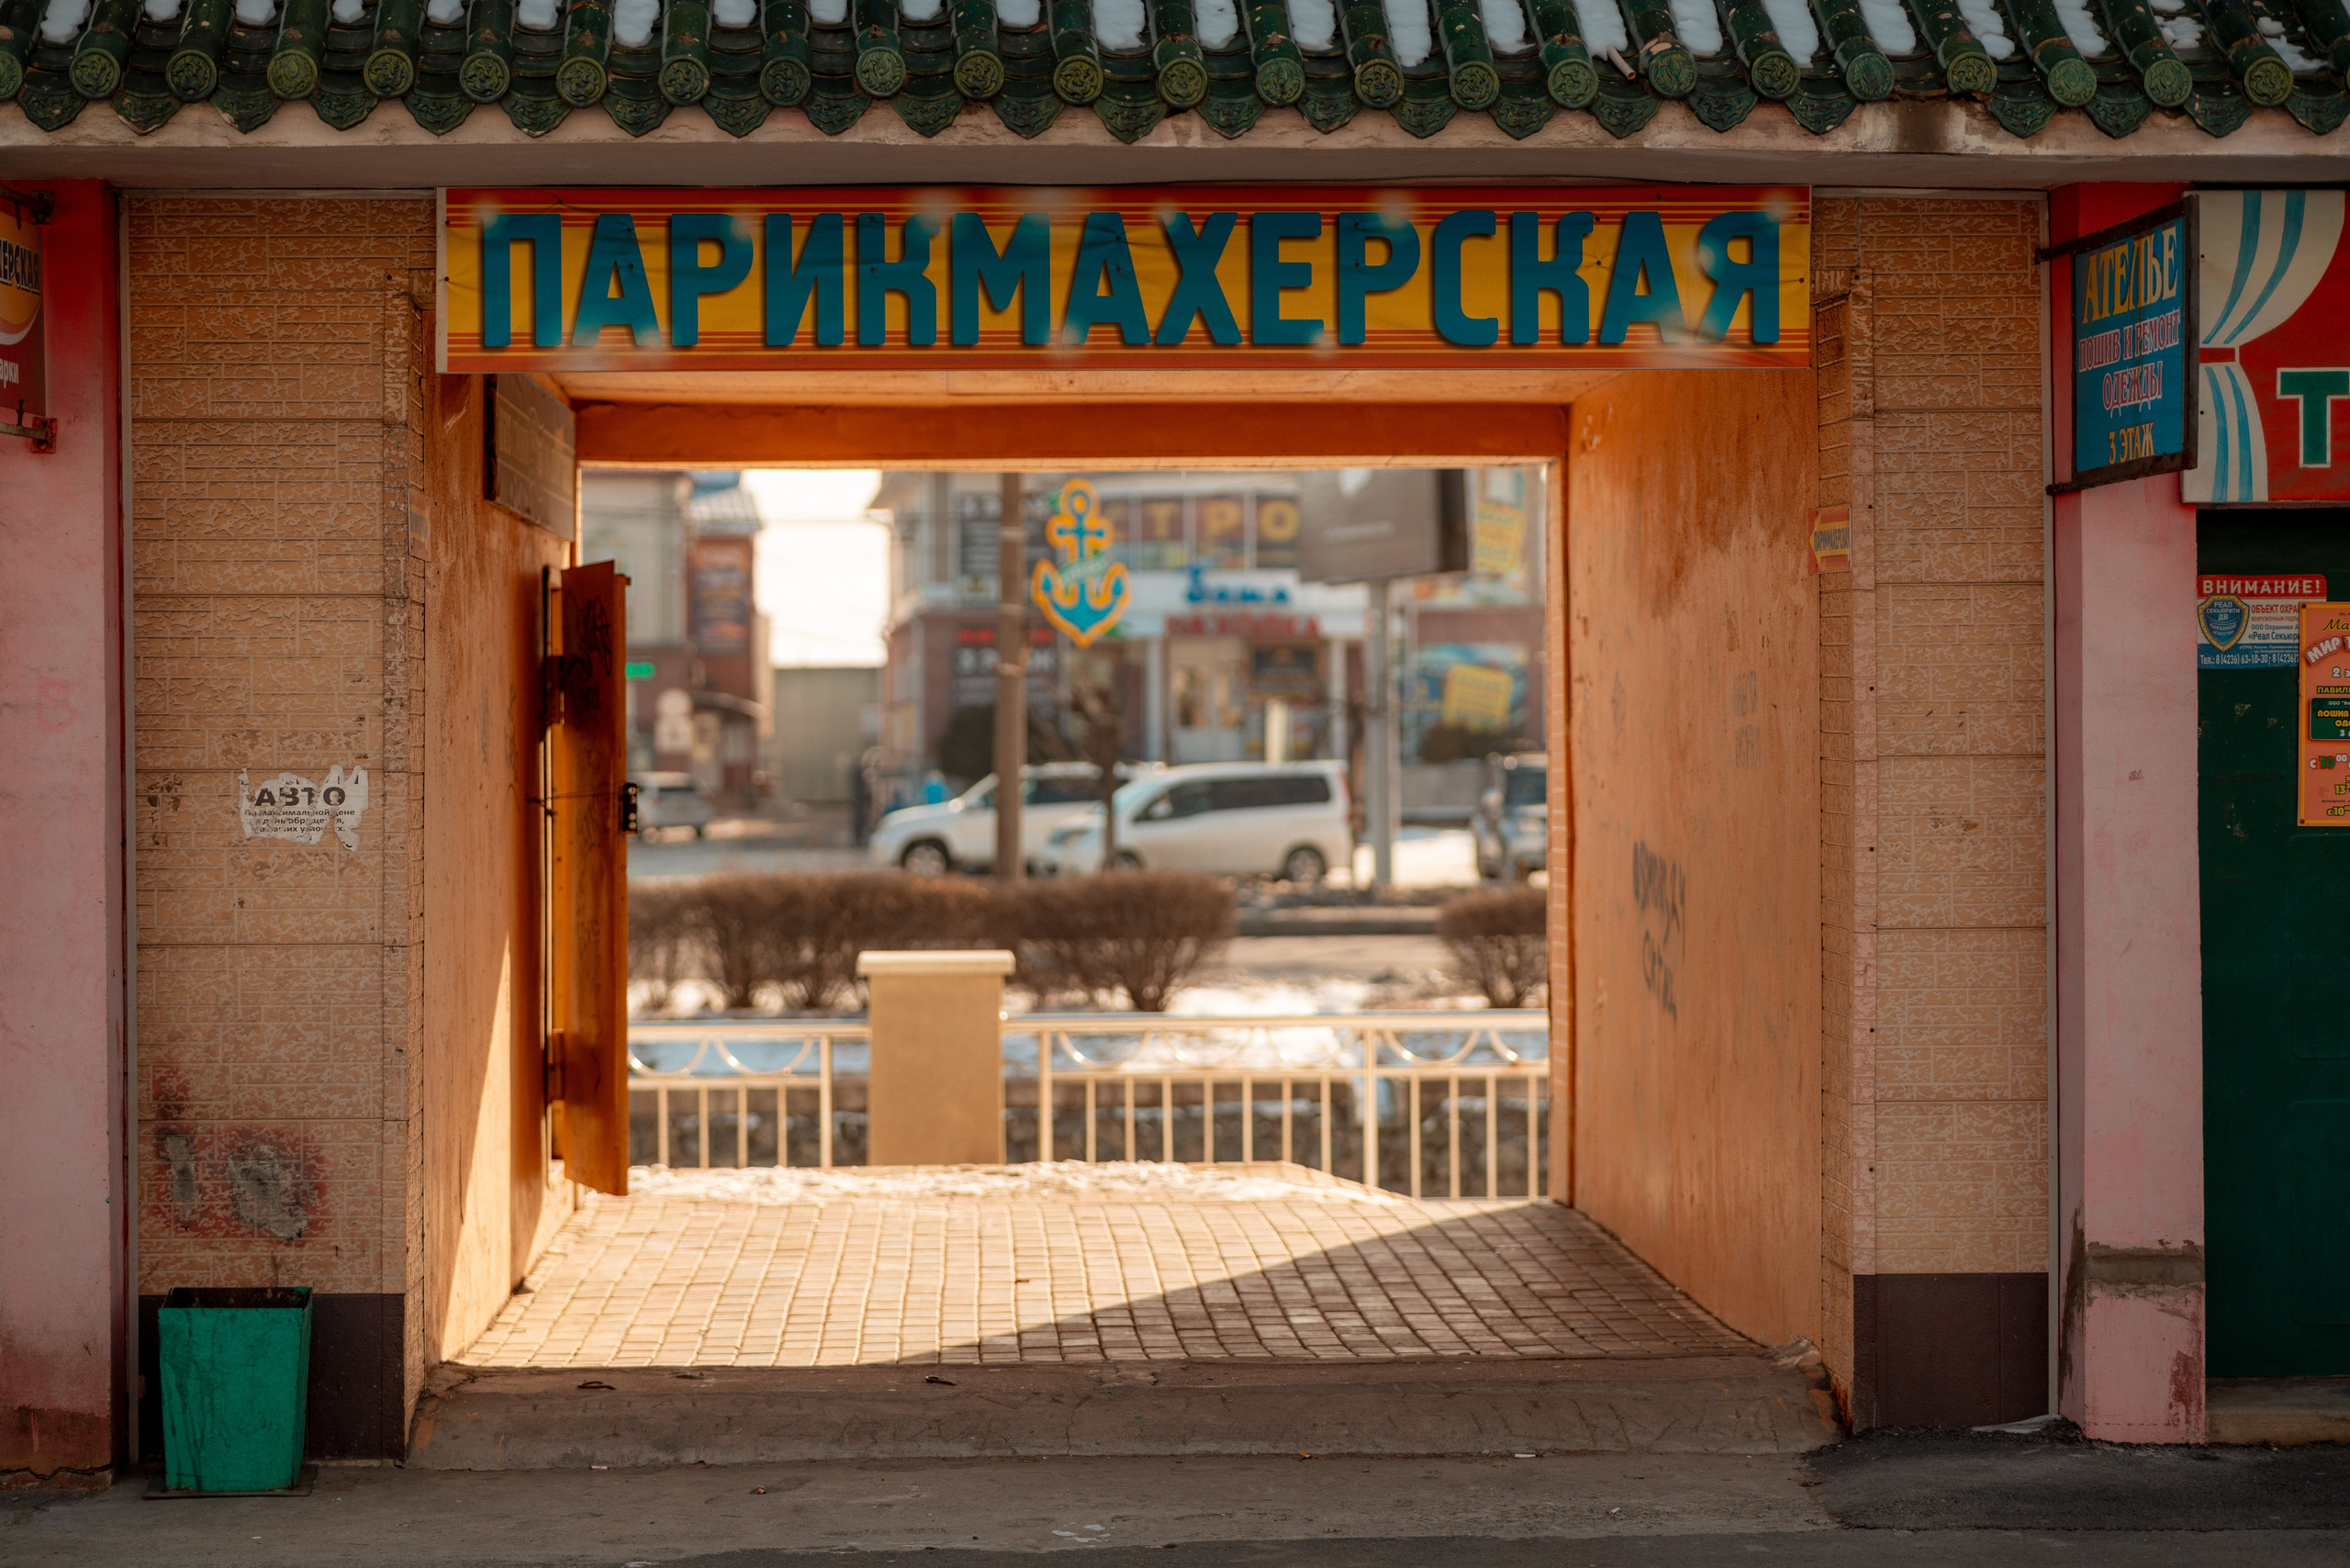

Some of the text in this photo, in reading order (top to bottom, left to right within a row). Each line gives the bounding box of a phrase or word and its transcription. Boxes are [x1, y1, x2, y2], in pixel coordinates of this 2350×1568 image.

[482, 210, 1781, 348] ПАРИКМАХЕРСКАЯ
[2082, 224, 2178, 324] АТЕЛЬЕ
[2078, 308, 2181, 372] ПОШИВ И РЕМОНТ
[2102, 361, 2164, 418] ОДЕЖДЫ
[2109, 422, 2155, 465] 3 ЭТАЖ
[2203, 579, 2320, 595] ВНИМАНИЕ!
[2251, 604, 2278, 613] ОБЪЕКТ
[2215, 655, 2220, 664] 8
[2221, 655, 2240, 665] (4236)
[2306, 635, 2341, 664] МИР
[2332, 666, 2341, 678] 2
[2317, 686, 2350, 694] ПАВИЛ
[254, 787, 346, 806] АВТО
